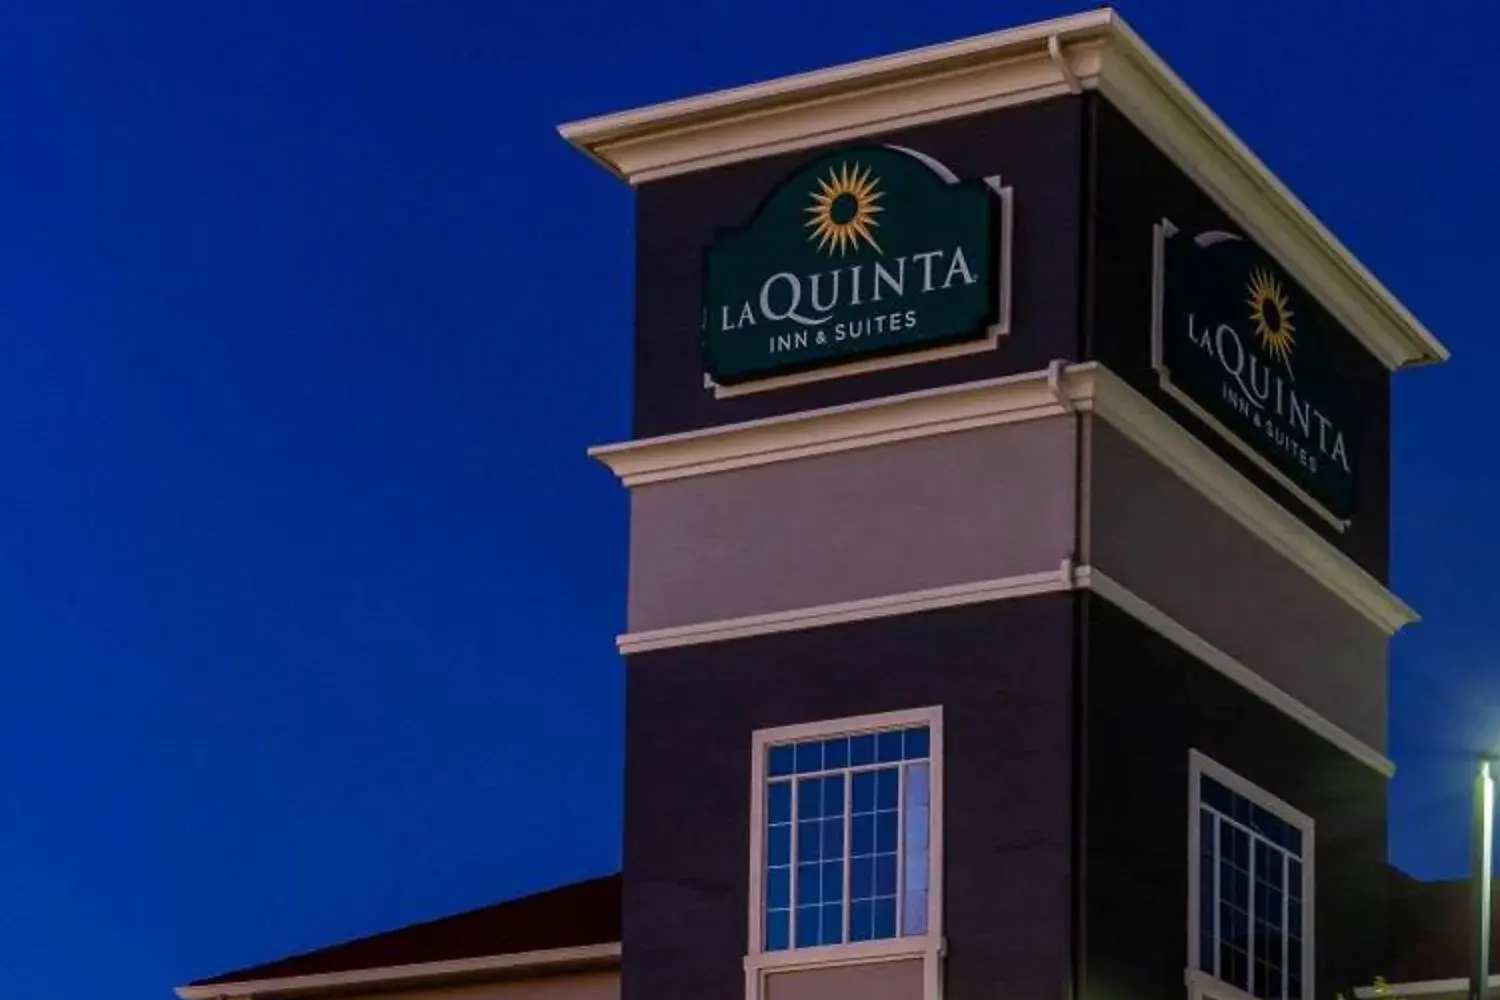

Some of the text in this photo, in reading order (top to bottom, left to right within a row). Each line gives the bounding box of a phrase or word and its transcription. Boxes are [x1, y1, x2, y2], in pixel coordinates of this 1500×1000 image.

[721, 246, 977, 331] LA QUINTA
[769, 310, 918, 354] INN & SUITES
[1188, 314, 1351, 473] LA QUINTA
[1222, 382, 1318, 473] INN & SUITES
